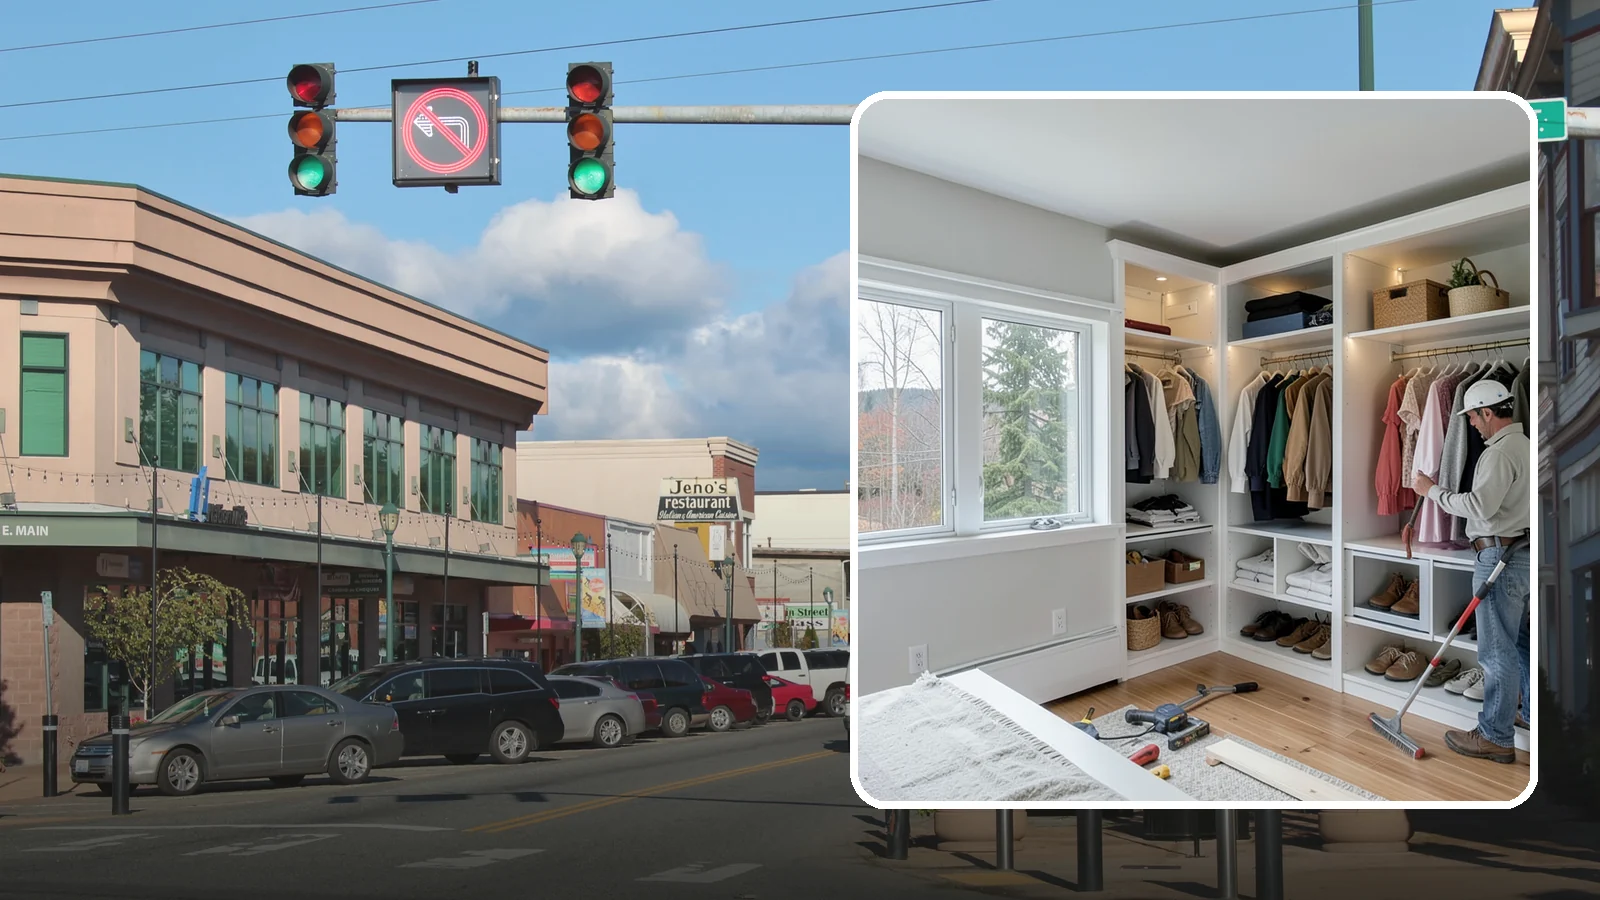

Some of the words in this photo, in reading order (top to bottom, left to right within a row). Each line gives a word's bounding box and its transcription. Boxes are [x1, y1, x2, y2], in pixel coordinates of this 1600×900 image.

[669, 480, 728, 495] Jeno's
[664, 496, 731, 509] restaurant
[658, 510, 681, 520] Italian
[685, 510, 715, 520] American
[715, 510, 738, 520] Cuisine
[2, 525, 13, 536] E.
[15, 525, 49, 536] MAIN
[797, 607, 828, 617] Street
[790, 619, 824, 627] lass
